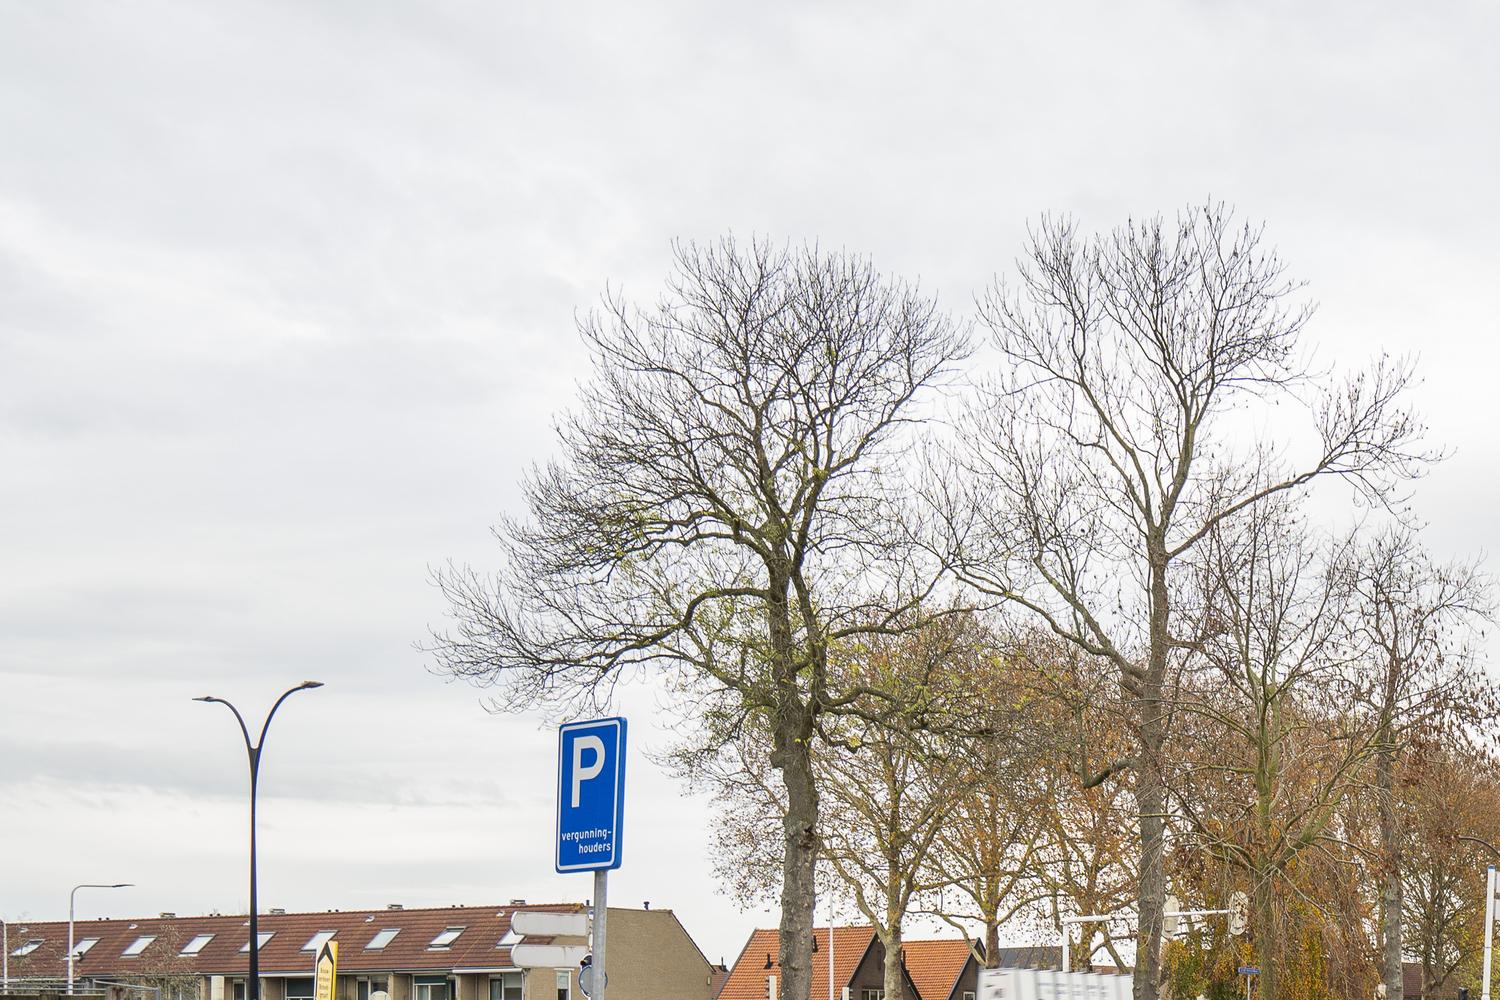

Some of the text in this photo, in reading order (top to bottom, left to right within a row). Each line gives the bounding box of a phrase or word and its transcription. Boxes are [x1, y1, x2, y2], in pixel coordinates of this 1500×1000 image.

[571, 735, 606, 808] P
[561, 828, 612, 843] vergunning-
[578, 841, 612, 854] houders
